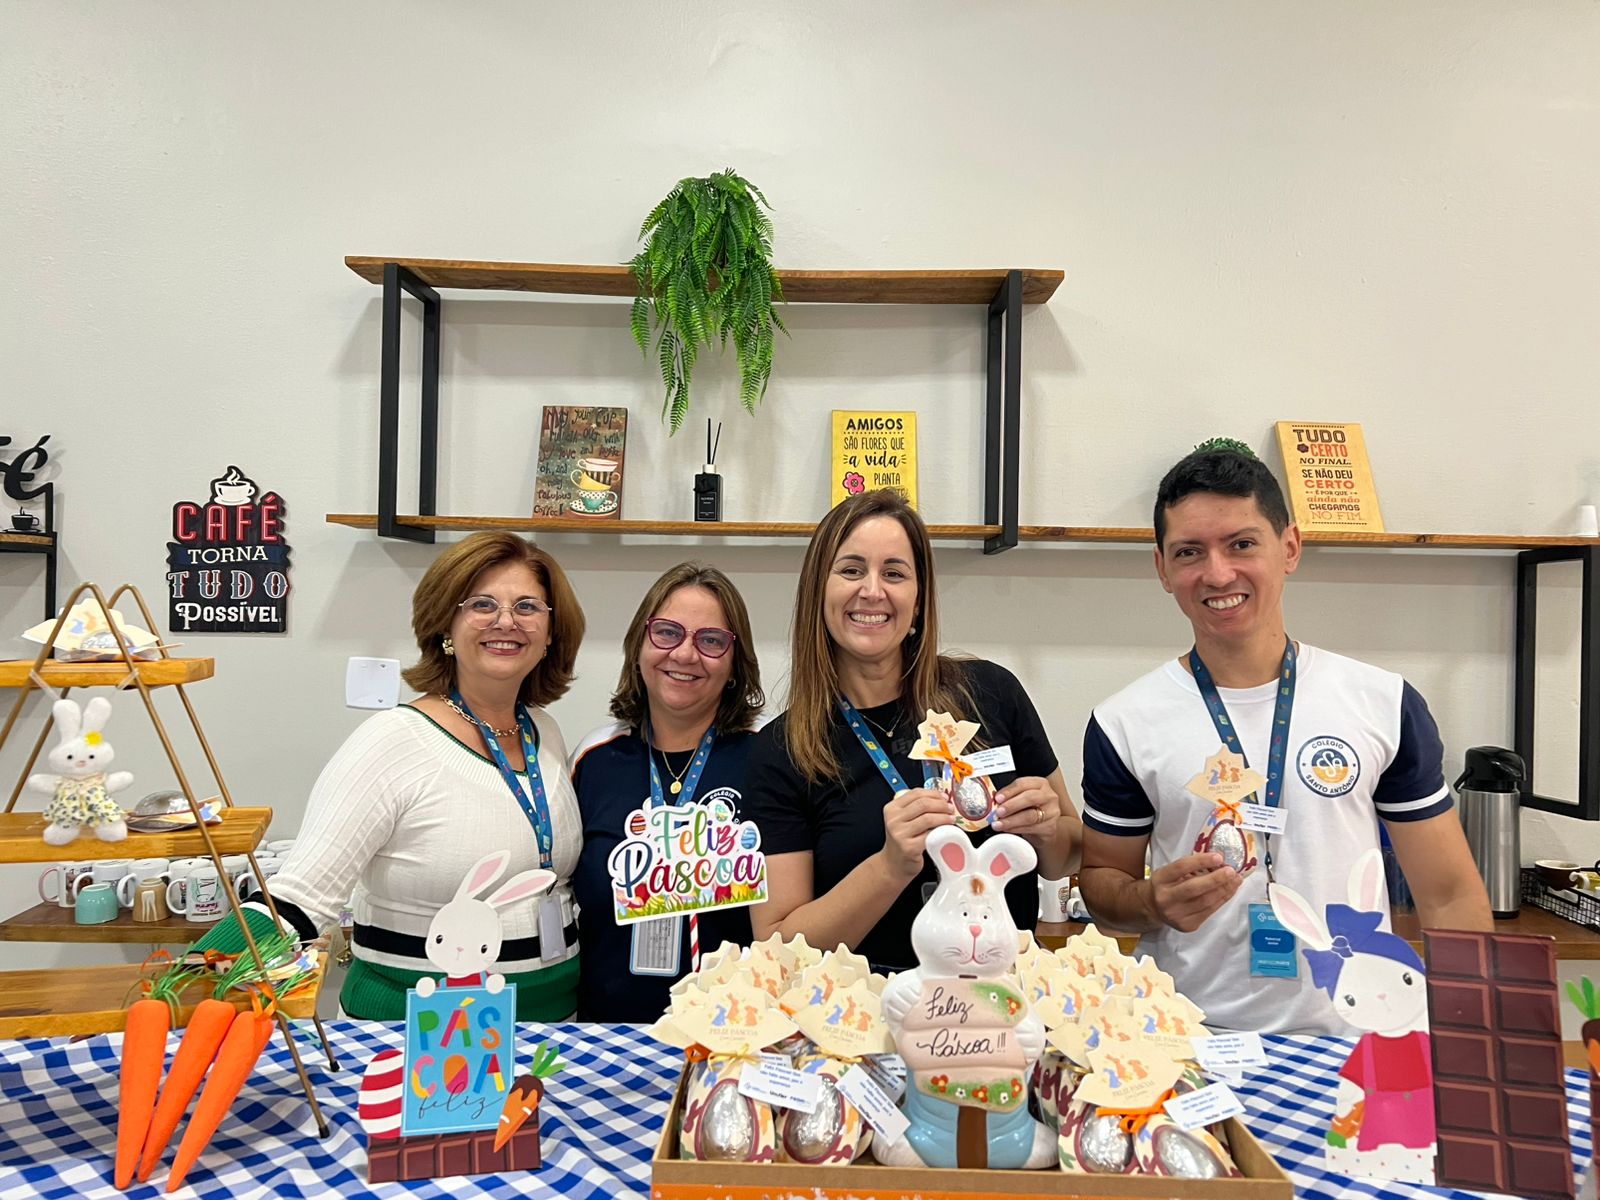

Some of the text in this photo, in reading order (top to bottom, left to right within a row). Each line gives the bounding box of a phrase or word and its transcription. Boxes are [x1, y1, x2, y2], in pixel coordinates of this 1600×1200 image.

[846, 418, 903, 430] AMIGOS
[843, 436, 905, 450] SÃO FLORES QUE
[1292, 429, 1346, 443] TUDO
[848, 450, 901, 468] a vida
[1310, 444, 1348, 457] CERTO
[874, 472, 901, 486] PLANTA
[1302, 468, 1353, 479] SE NÃO DEU
[1304, 480, 1355, 489] CERTO
[1308, 503, 1361, 511] CHEGAMOS
[1311, 511, 1333, 520] NO
[176, 495, 279, 541] CAFÉ
[188, 546, 269, 565] TORNA
[168, 569, 289, 599] TUDO
[1311, 739, 1344, 750] COLÉGIO
[1305, 774, 1329, 793] SANTO
[1329, 774, 1355, 794] ANTÔNIO
[651, 806, 739, 860] Feliz
[612, 840, 762, 898] Páscoa
[925, 986, 974, 1024] Feliz
[416, 997, 503, 1050] PÁS
[411, 1053, 505, 1099] COA
[418, 1082, 503, 1120] feliz
